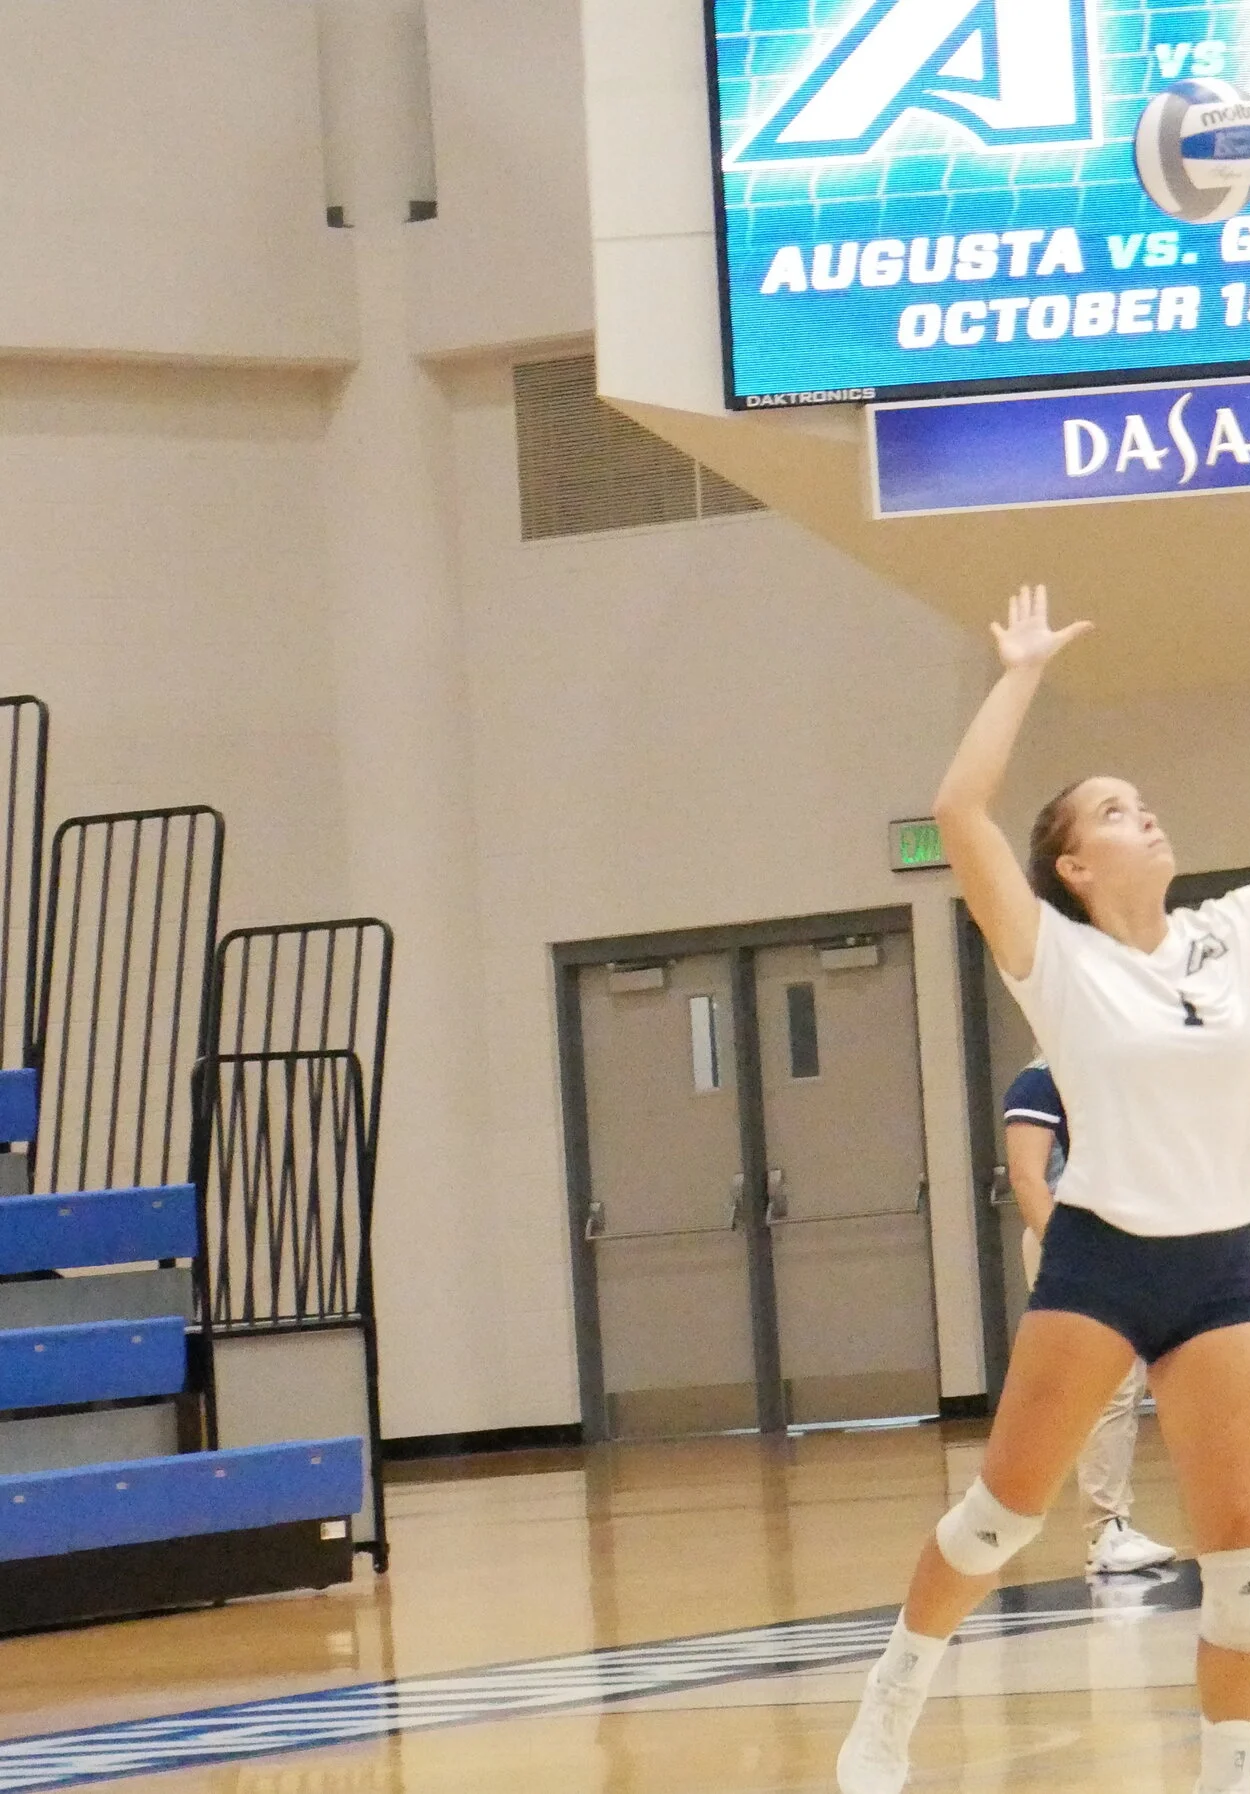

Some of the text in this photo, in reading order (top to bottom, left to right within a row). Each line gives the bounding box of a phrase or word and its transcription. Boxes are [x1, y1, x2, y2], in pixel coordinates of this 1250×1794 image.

[759, 227, 1085, 295] AUGUSTA
[897, 285, 1202, 350] OCTOBER
[745, 387, 877, 408] DAKTRONICS
